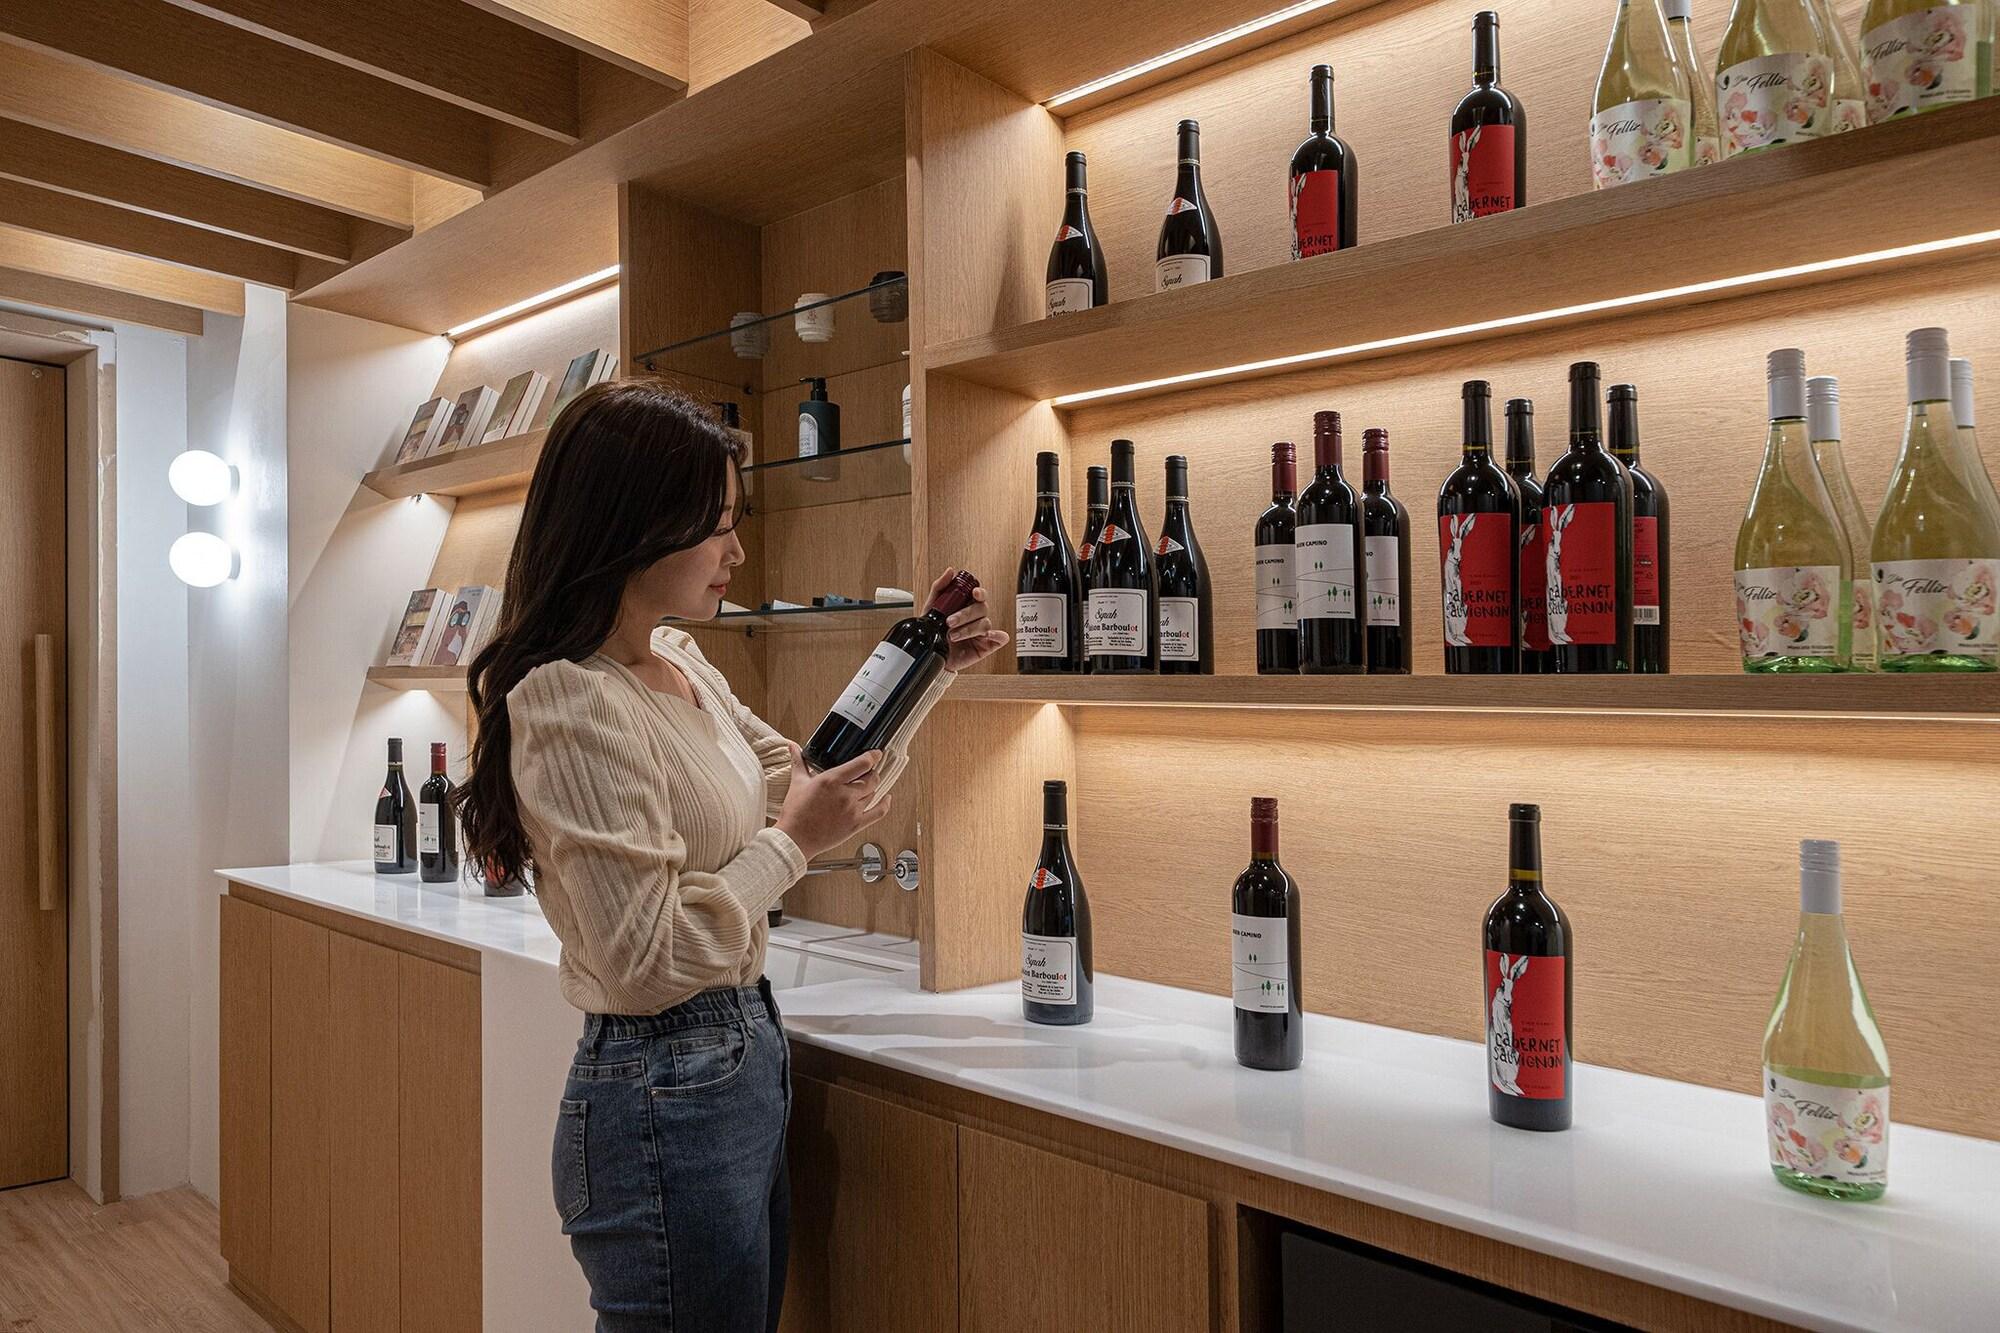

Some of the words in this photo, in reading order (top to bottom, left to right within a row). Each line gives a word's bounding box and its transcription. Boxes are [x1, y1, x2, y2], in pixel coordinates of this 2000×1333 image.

[1024, 626, 1058, 634] Barboulot
[1101, 623, 1138, 631] Barboulot
[1031, 970, 1067, 980] Barboulot
